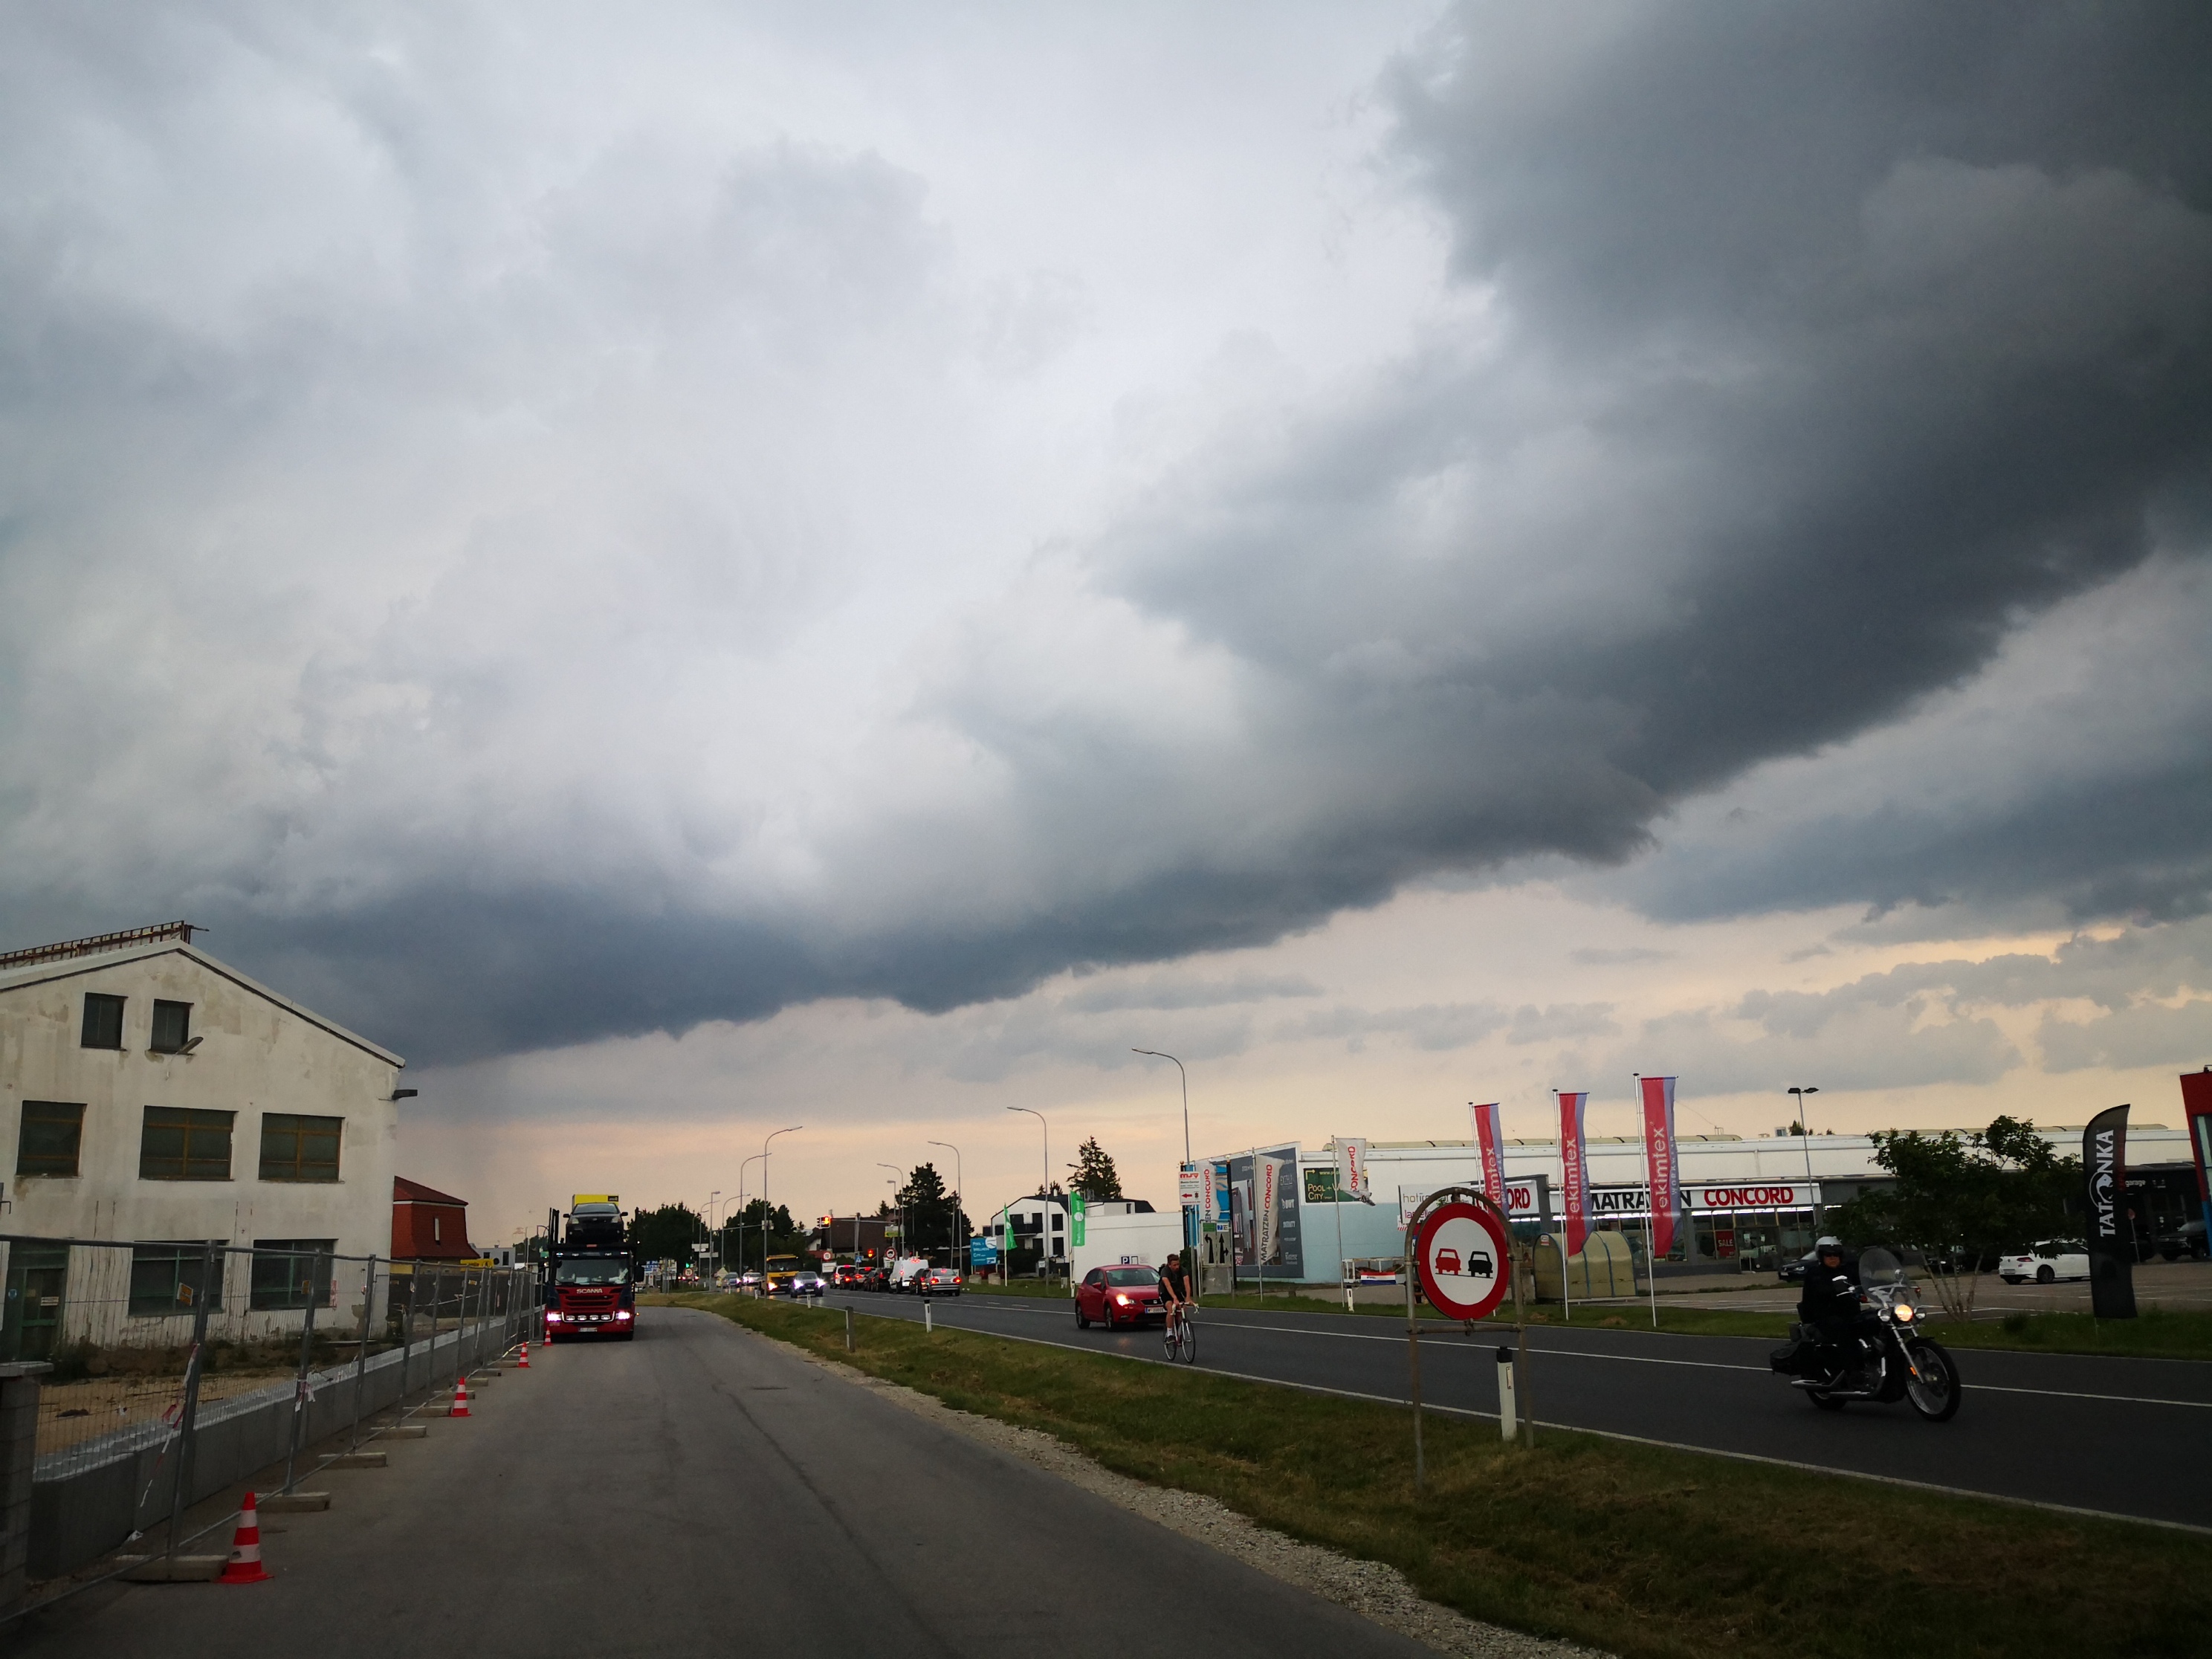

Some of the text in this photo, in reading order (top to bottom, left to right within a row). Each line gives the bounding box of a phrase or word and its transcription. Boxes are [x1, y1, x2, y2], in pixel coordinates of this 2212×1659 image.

[1348, 1146, 1359, 1191] ONCORD
[1565, 1139, 1580, 1214] ekimtex
[1652, 1127, 1669, 1209] ekimtex
[1704, 1186, 1794, 1206] CONCORD
[2095, 1129, 2116, 1238] TATONKA
[1261, 1164, 1273, 1261] MATRATZEN CONCORD
[1717, 1238, 1734, 1248] SALE
